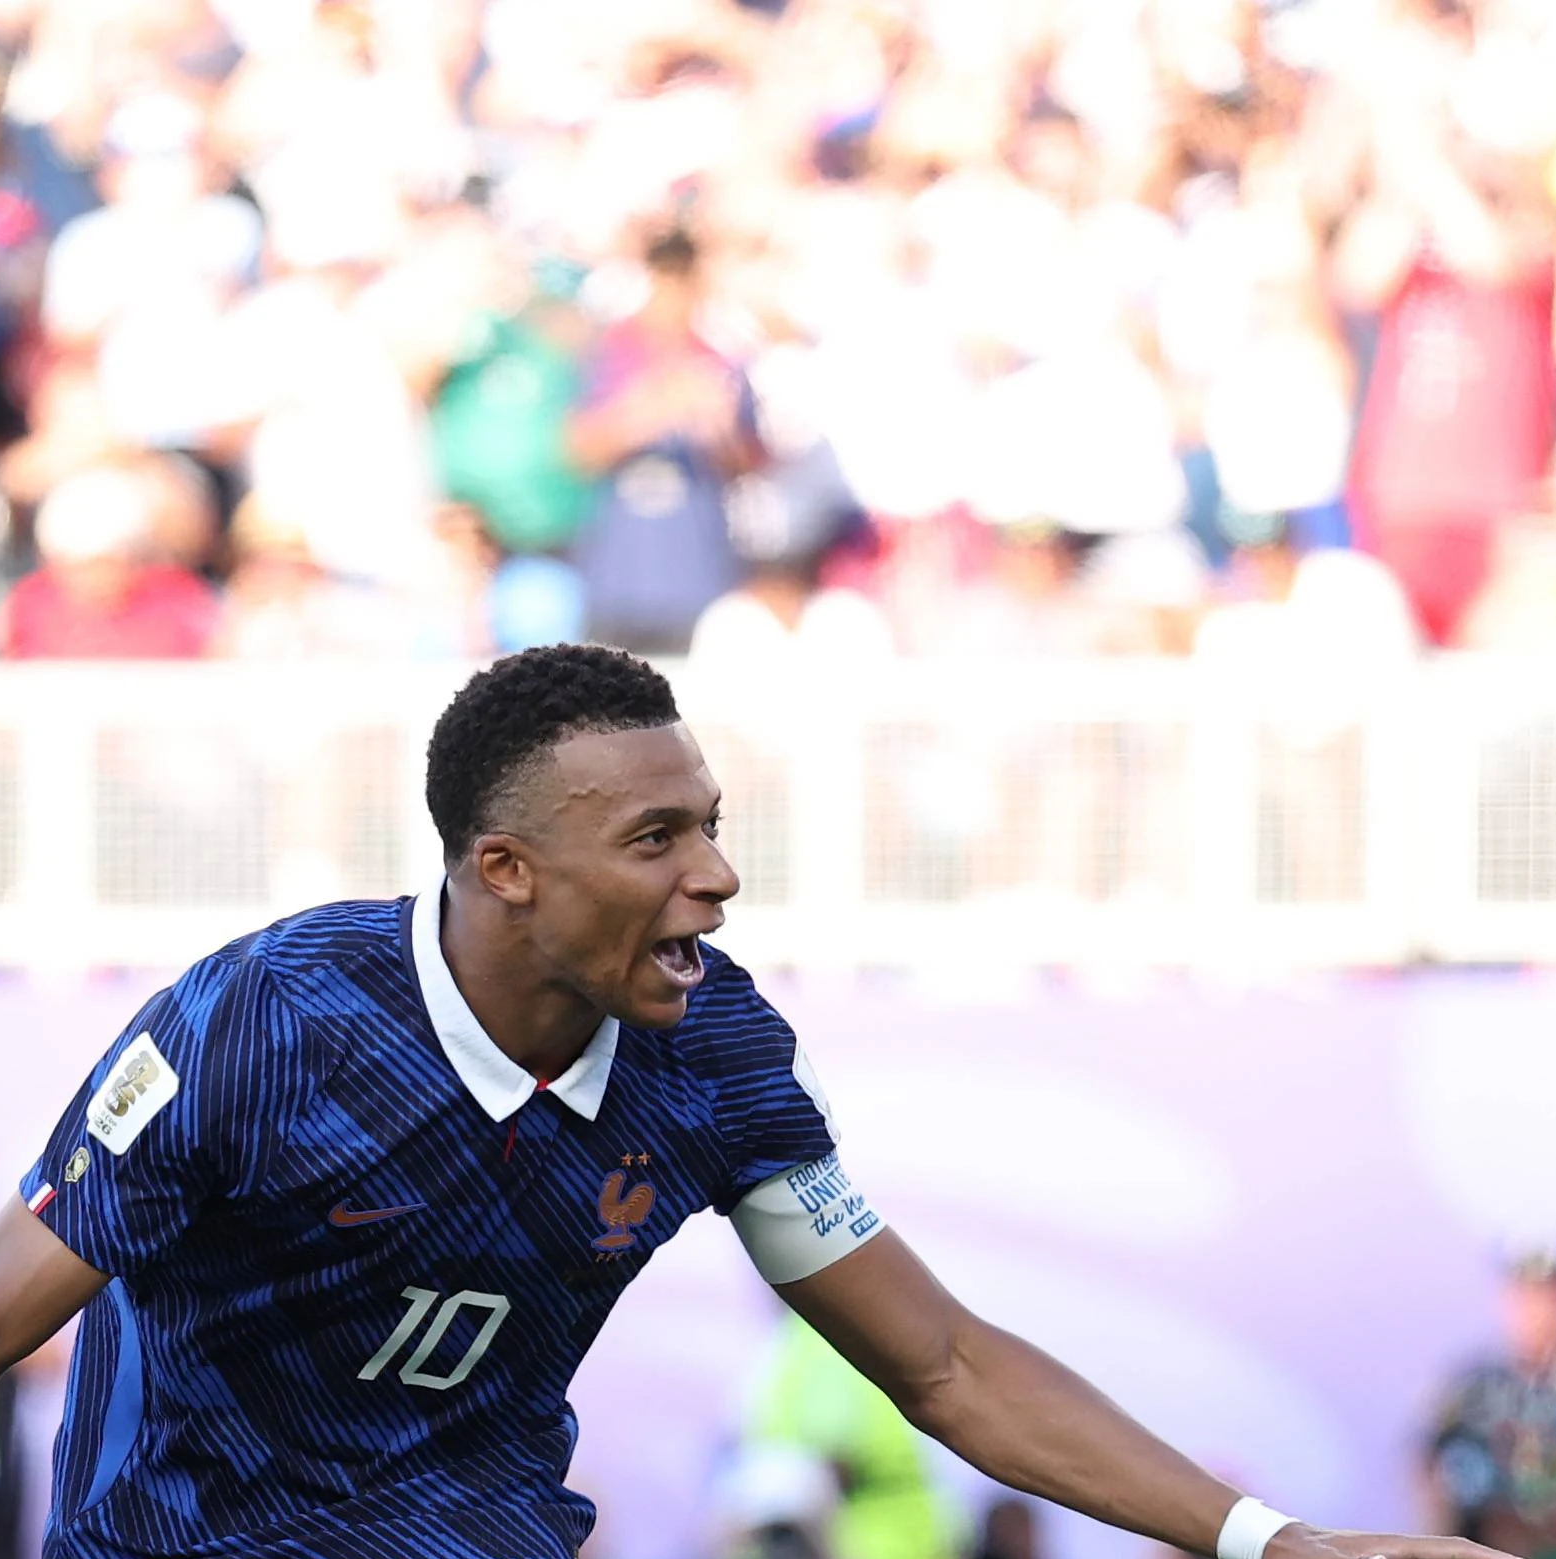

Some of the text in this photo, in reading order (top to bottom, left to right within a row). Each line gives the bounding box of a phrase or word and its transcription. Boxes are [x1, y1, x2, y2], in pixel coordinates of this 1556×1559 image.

[797, 1164, 851, 1214] UNITE
[810, 1211, 845, 1236] the
[356, 1286, 511, 1390] 10
